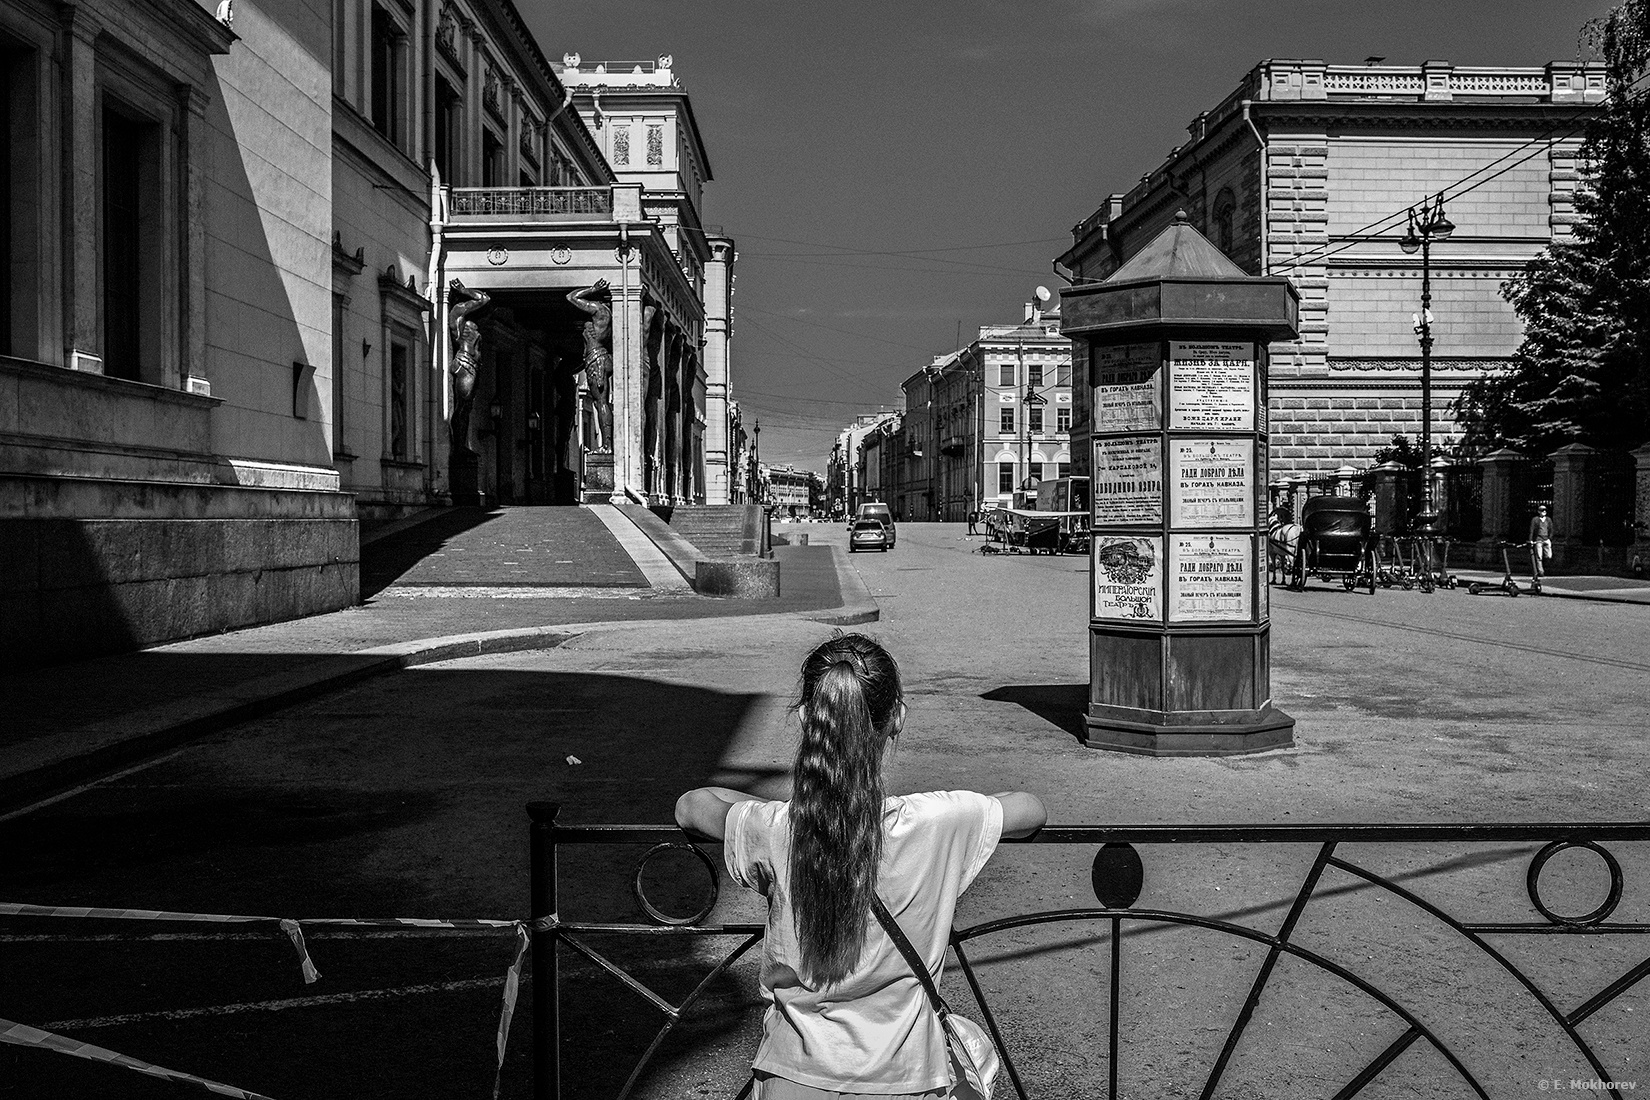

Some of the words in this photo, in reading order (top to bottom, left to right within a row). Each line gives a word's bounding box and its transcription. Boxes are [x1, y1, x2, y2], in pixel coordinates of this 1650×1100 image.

[1173, 358, 1206, 367] ЖИЗНЬ
[1208, 358, 1221, 367] ЗА
[1181, 468, 1198, 478] РАДИ
[1200, 467, 1226, 478] ДОБРАГО
[1180, 562, 1196, 572] РАДИ
[1198, 562, 1224, 572] ДОБРАГО
